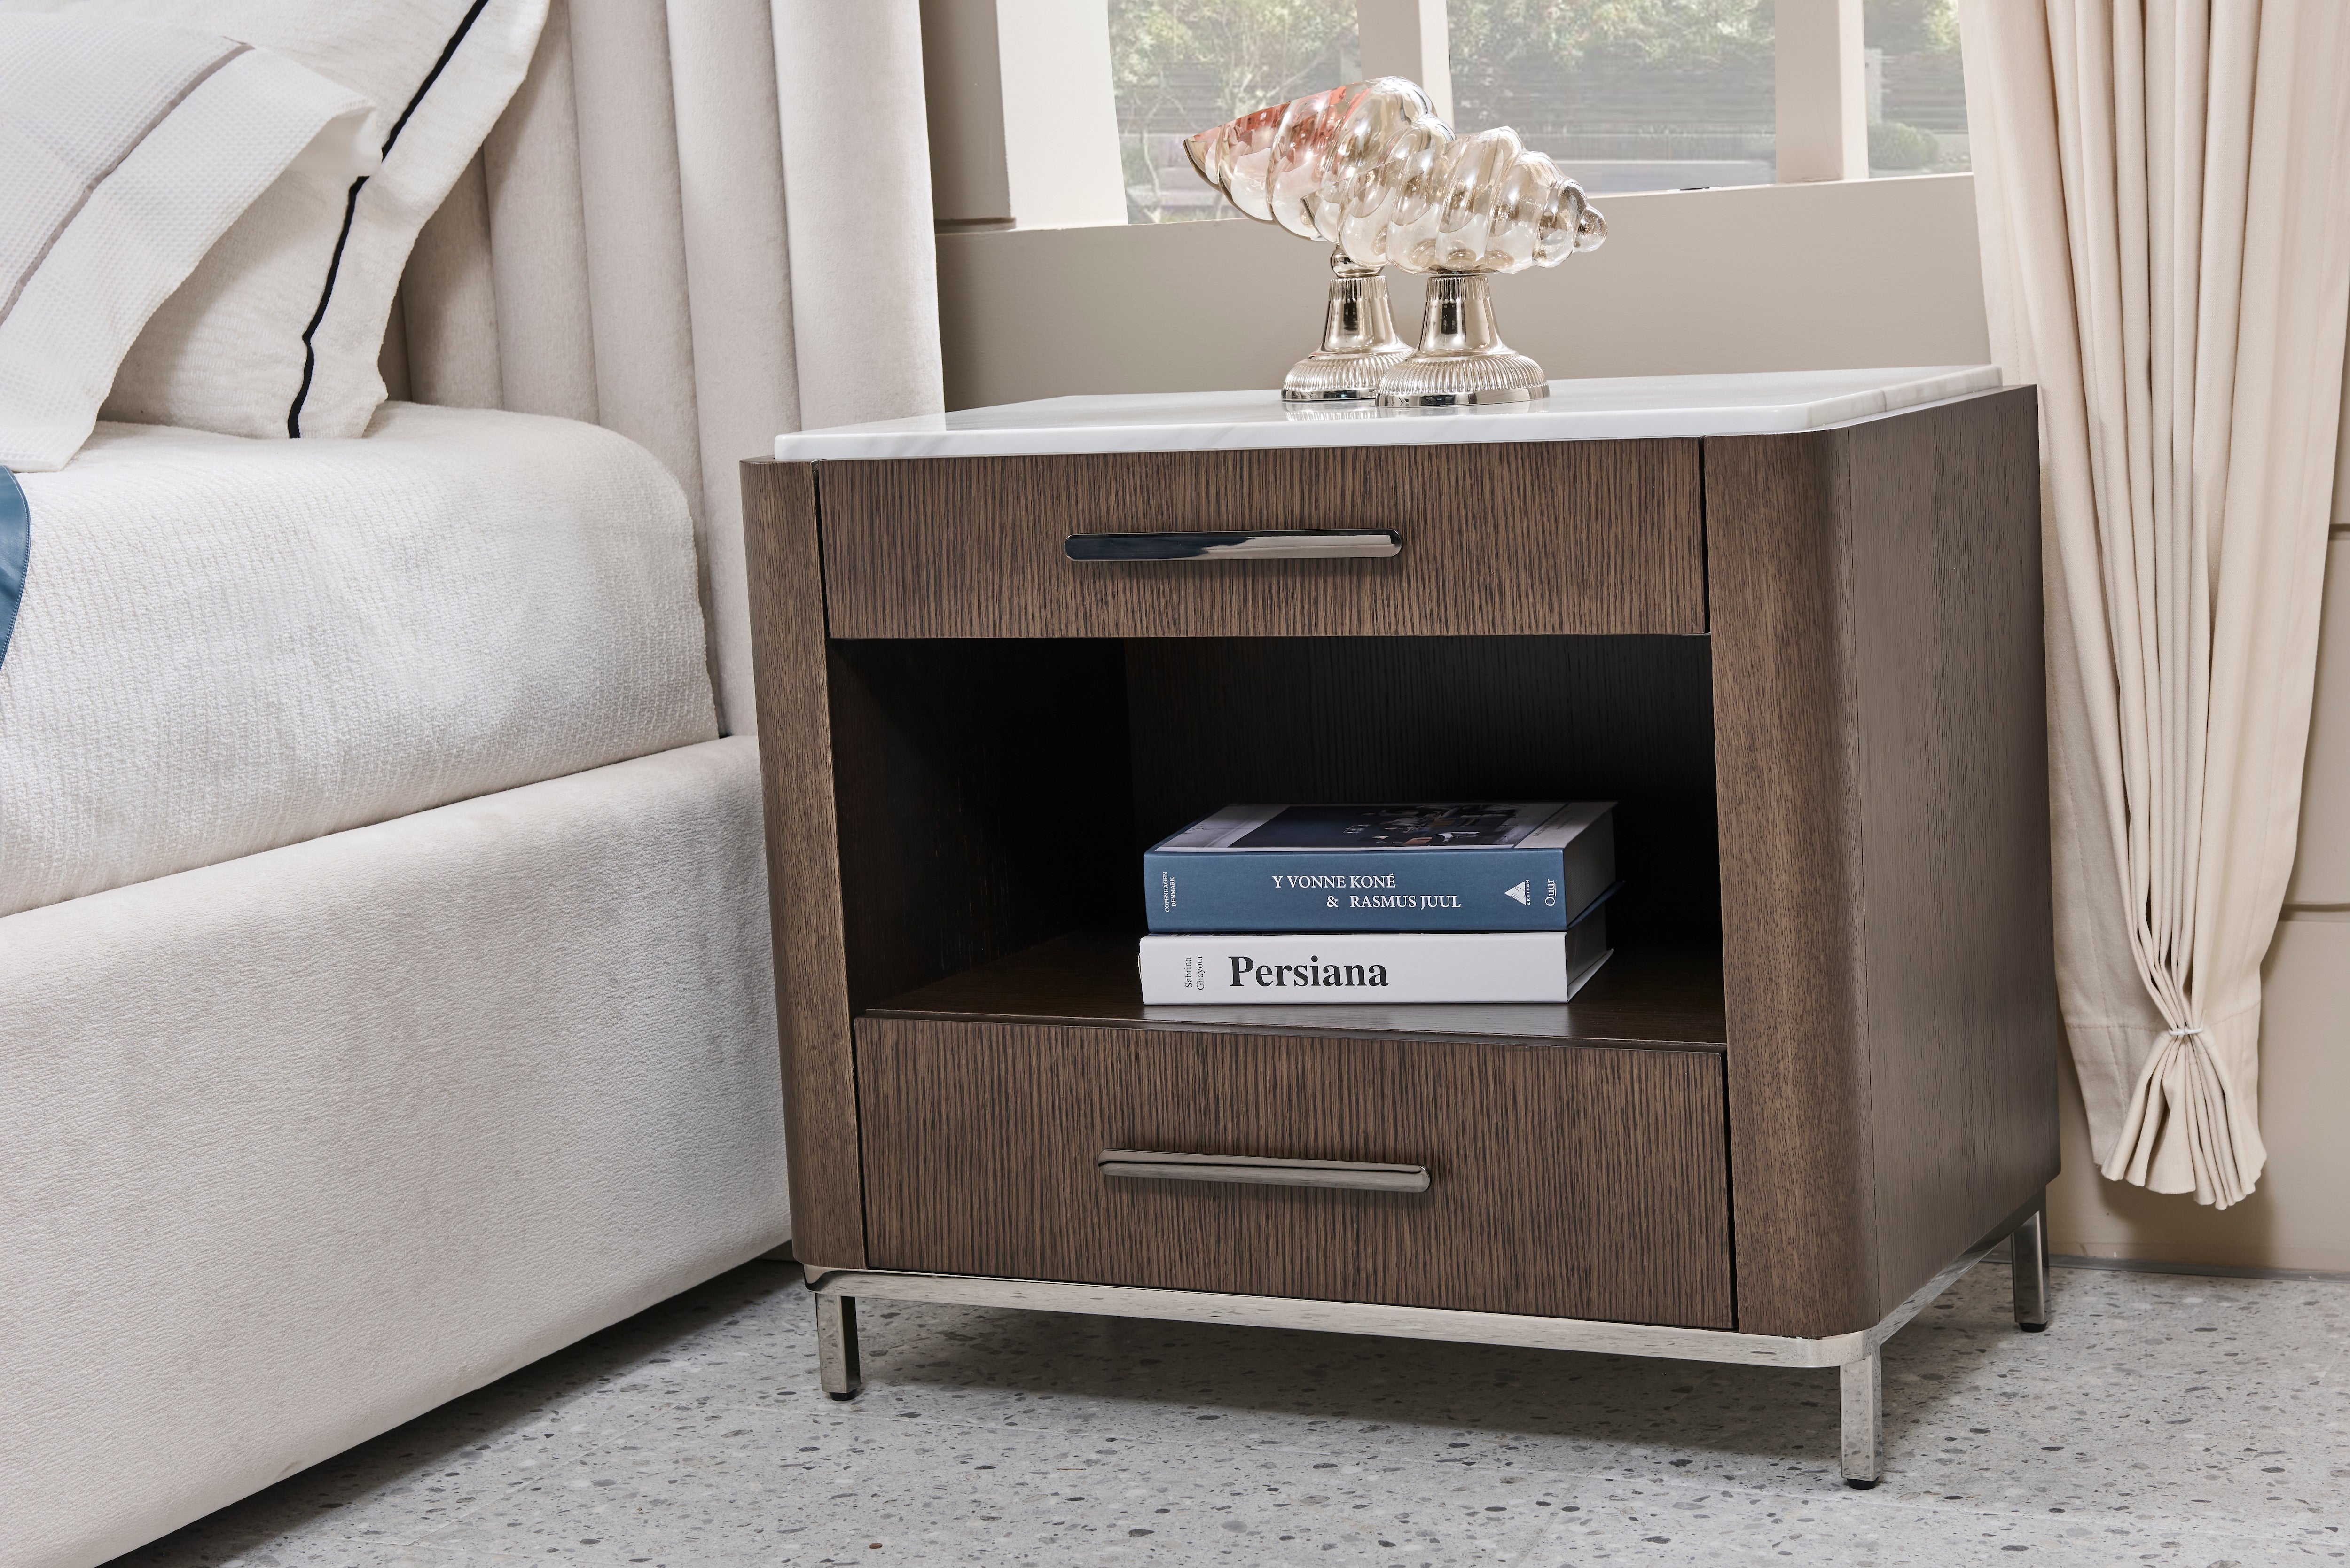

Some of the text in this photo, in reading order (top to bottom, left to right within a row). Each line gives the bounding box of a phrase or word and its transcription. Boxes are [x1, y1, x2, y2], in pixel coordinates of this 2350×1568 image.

[1349, 872, 1396, 888] KONÉ
[1326, 895, 1461, 910] & RASMUS JUUL
[1184, 958, 1193, 988] Sabrina
[1197, 955, 1206, 990] Ghayour
[1228, 955, 1389, 987] Persiana
